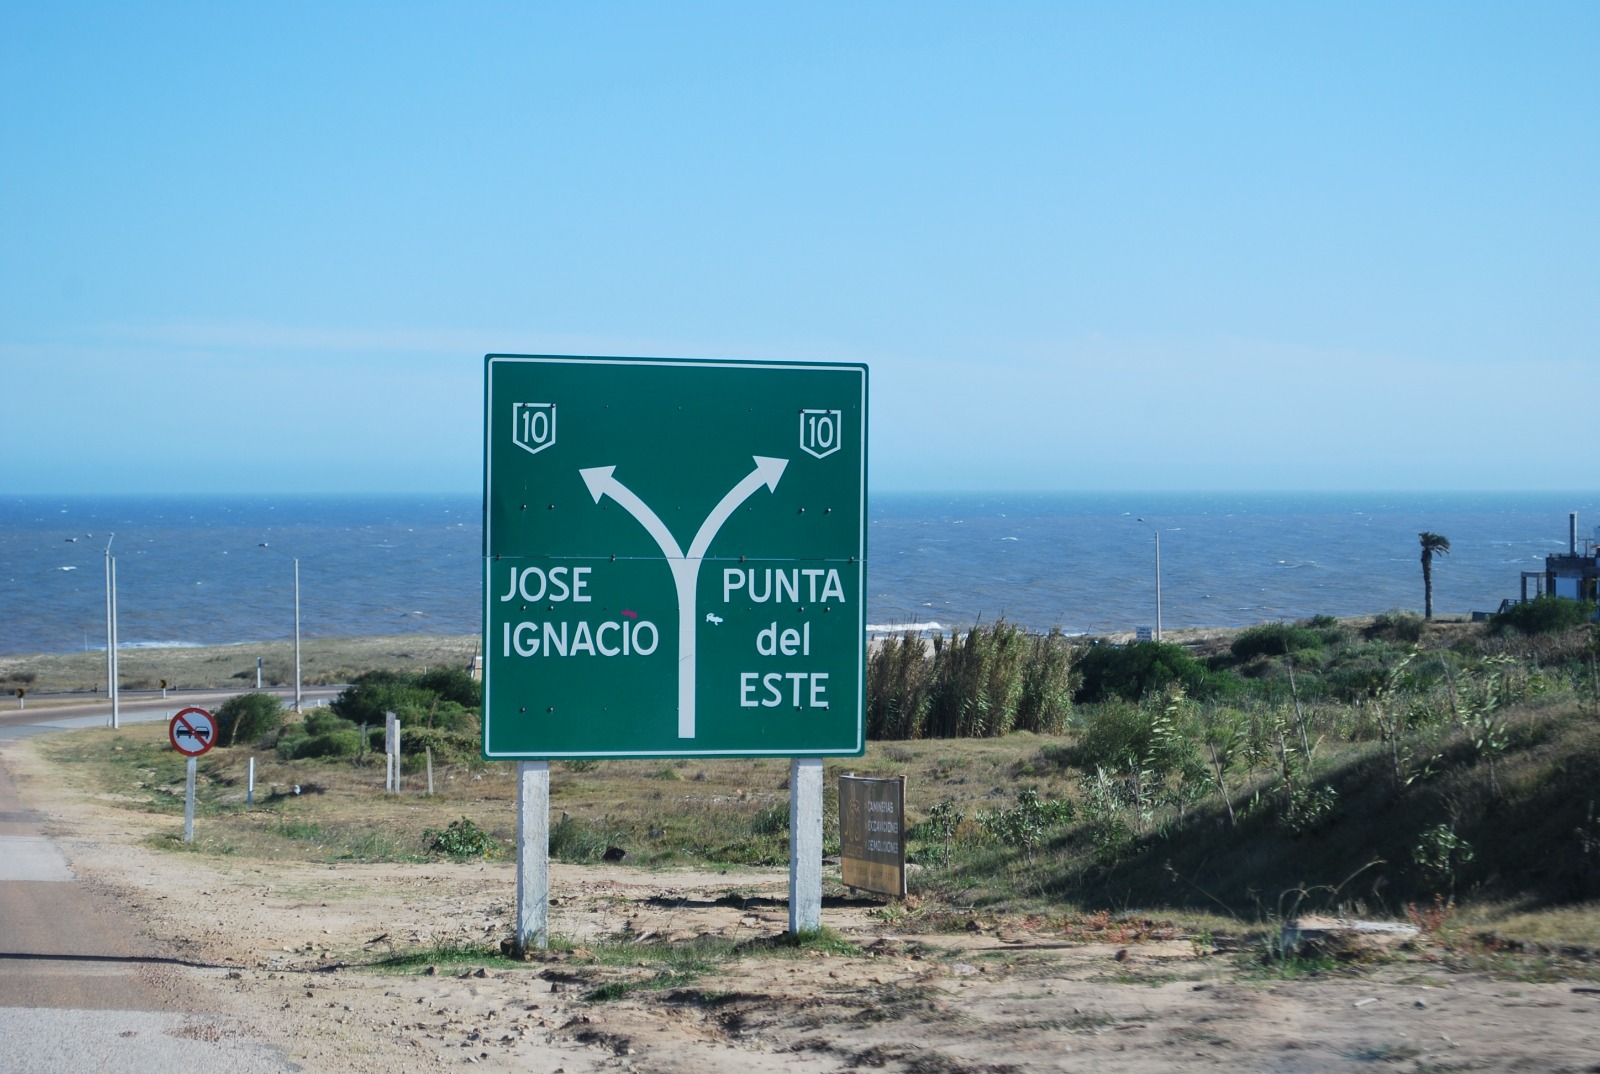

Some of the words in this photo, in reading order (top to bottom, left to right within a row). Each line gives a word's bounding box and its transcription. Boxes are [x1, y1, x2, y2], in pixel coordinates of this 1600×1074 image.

[522, 411, 548, 443] 10
[808, 416, 833, 448] 10
[500, 566, 592, 602] JOSE
[723, 568, 845, 603] PUNTA
[503, 621, 659, 657] IGNACIO
[756, 621, 810, 656] del
[740, 672, 829, 707] ESTE
